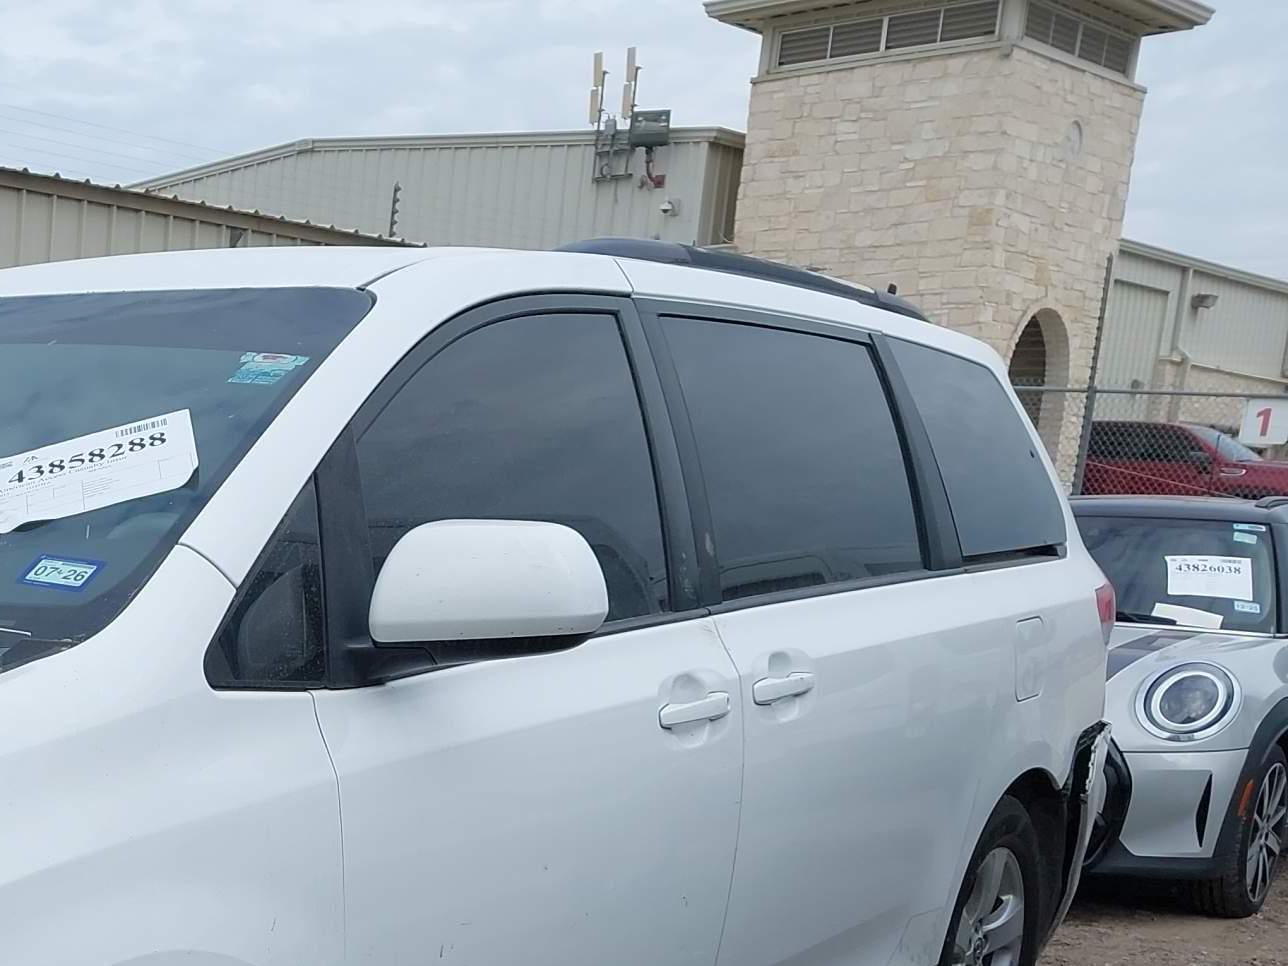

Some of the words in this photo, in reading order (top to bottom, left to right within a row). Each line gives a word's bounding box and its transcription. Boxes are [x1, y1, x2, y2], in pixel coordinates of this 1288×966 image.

[1256, 407, 1272, 437] 1
[7, 431, 167, 484] 43858288
[1175, 563, 1241, 574] 43826038
